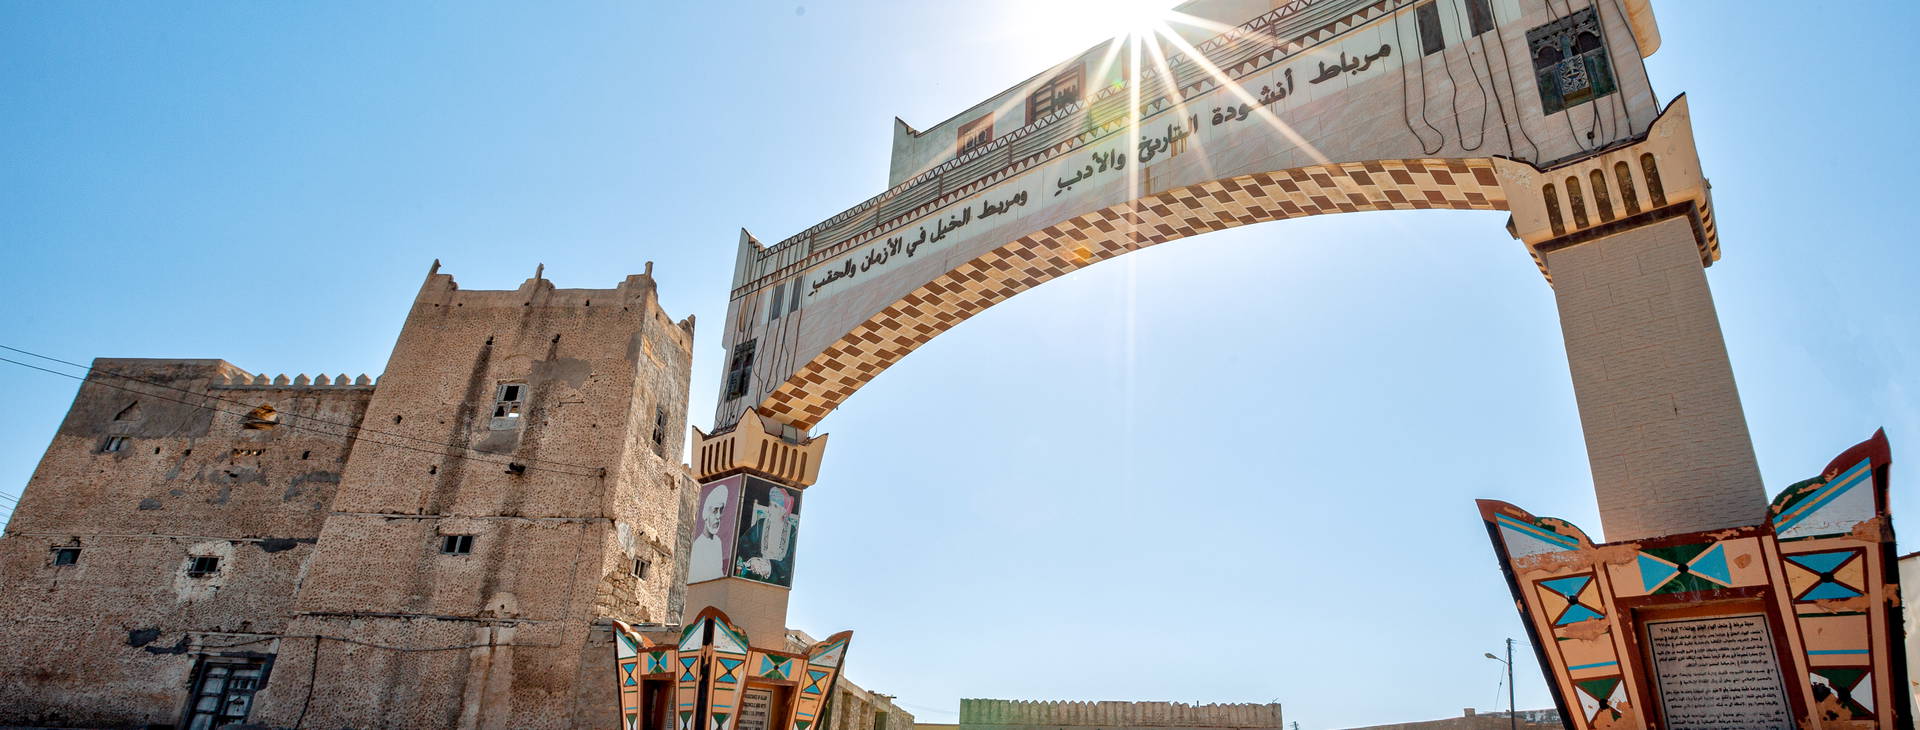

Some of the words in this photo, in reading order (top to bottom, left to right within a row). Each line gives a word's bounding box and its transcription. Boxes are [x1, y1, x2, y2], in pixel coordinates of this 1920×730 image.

[1308, 43, 1392, 85] مرباط
[977, 189, 1028, 220] ومربط
[905, 226, 926, 257] في
[930, 206, 971, 243] الخيل
